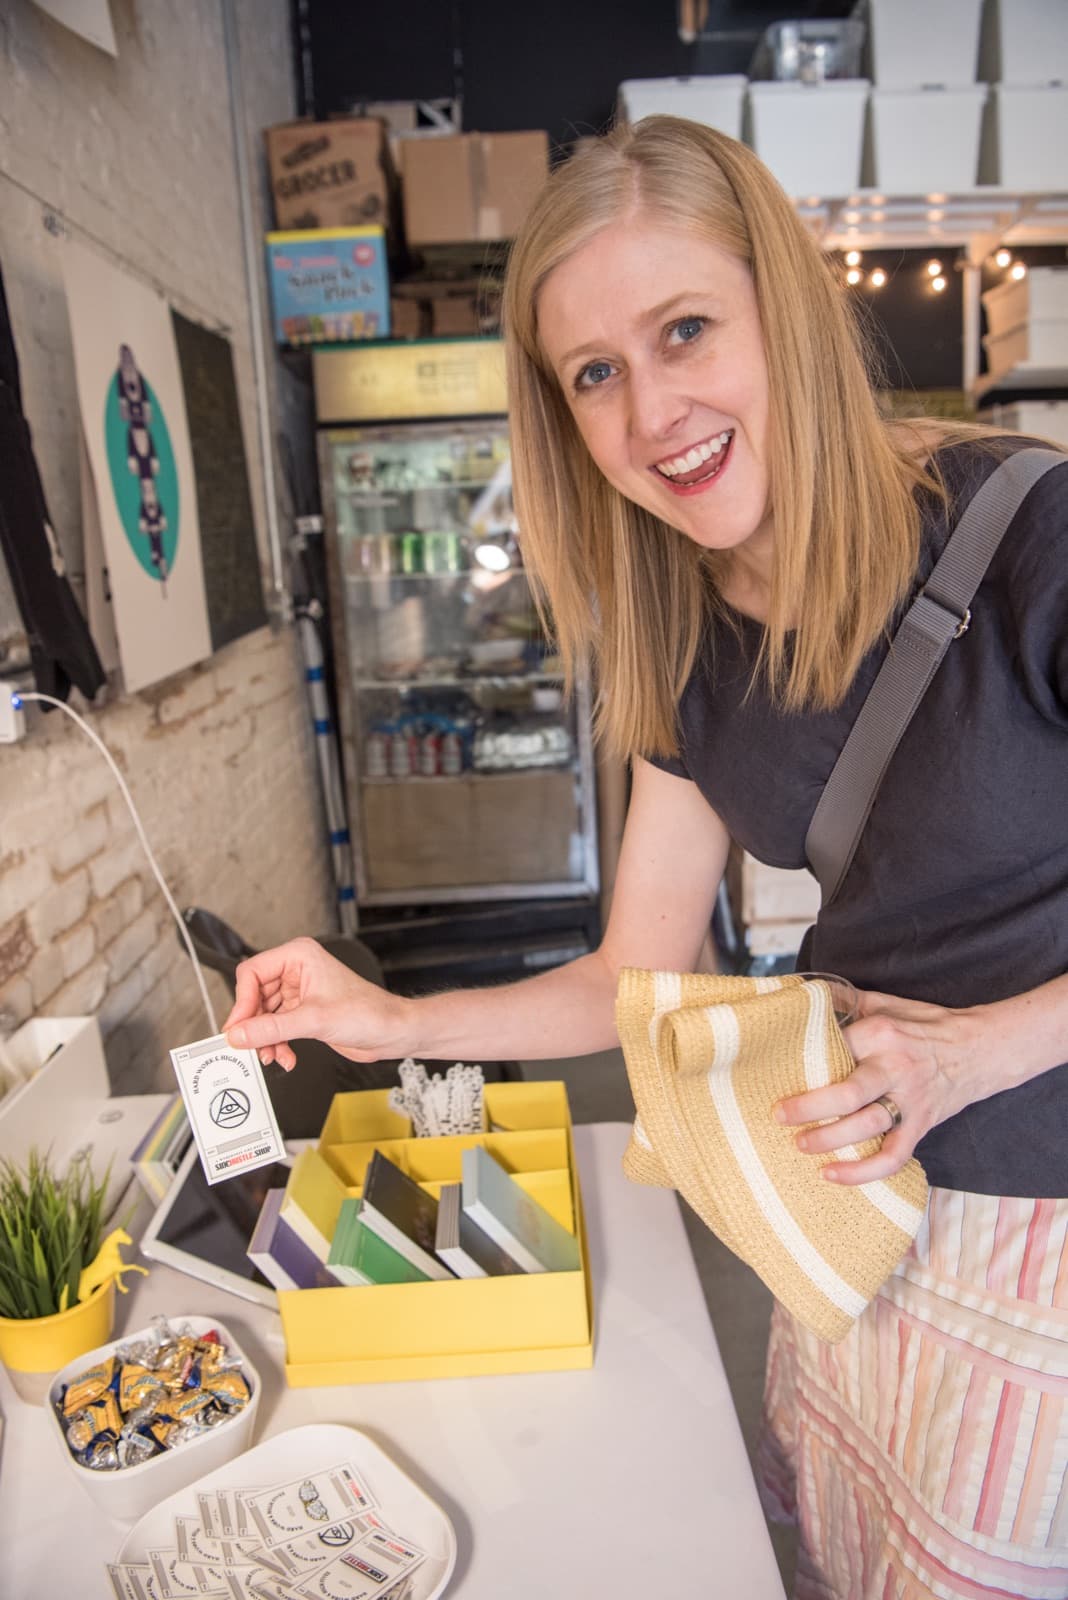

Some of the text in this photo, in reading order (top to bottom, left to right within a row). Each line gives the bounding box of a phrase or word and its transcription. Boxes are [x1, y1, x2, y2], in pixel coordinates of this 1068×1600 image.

[192, 1075, 200, 1095] HARD
[196, 1057, 214, 1075] WORK
[220, 1055, 237, 1064] HIGH
[236, 1060, 251, 1078] FIVES
[215, 1145, 272, 1171] SIDEHUSTLE.SHOP
